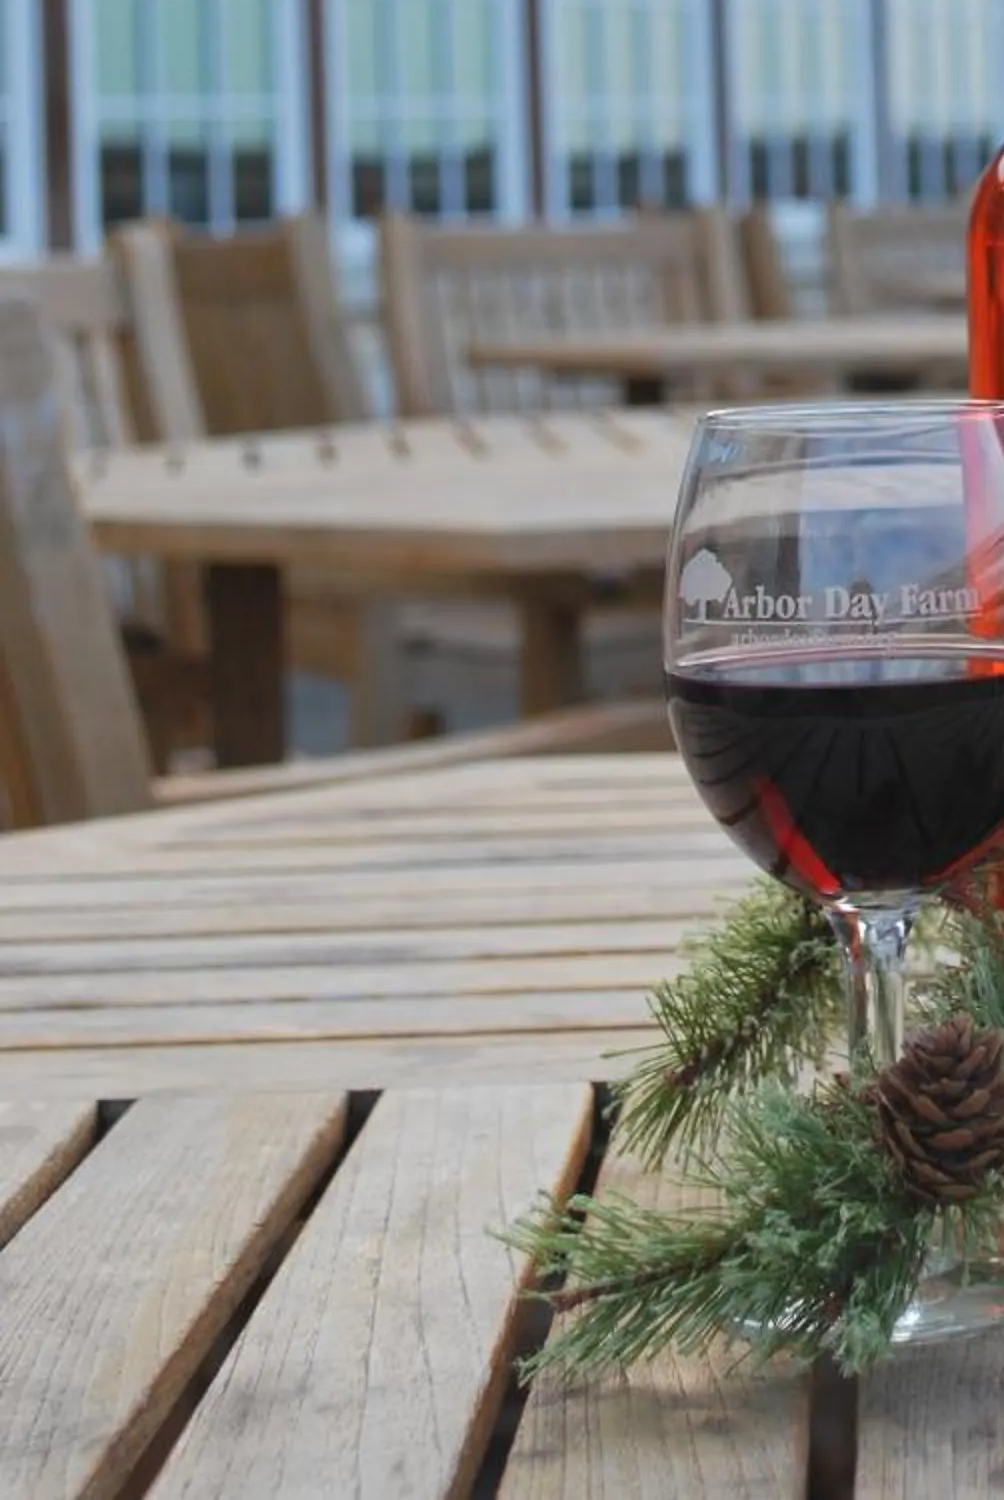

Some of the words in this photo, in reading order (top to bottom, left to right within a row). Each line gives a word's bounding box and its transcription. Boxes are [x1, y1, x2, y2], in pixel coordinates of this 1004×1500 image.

[722, 585, 814, 619] Arbor
[824, 586, 891, 624] Day
[900, 584, 983, 617] Farm
